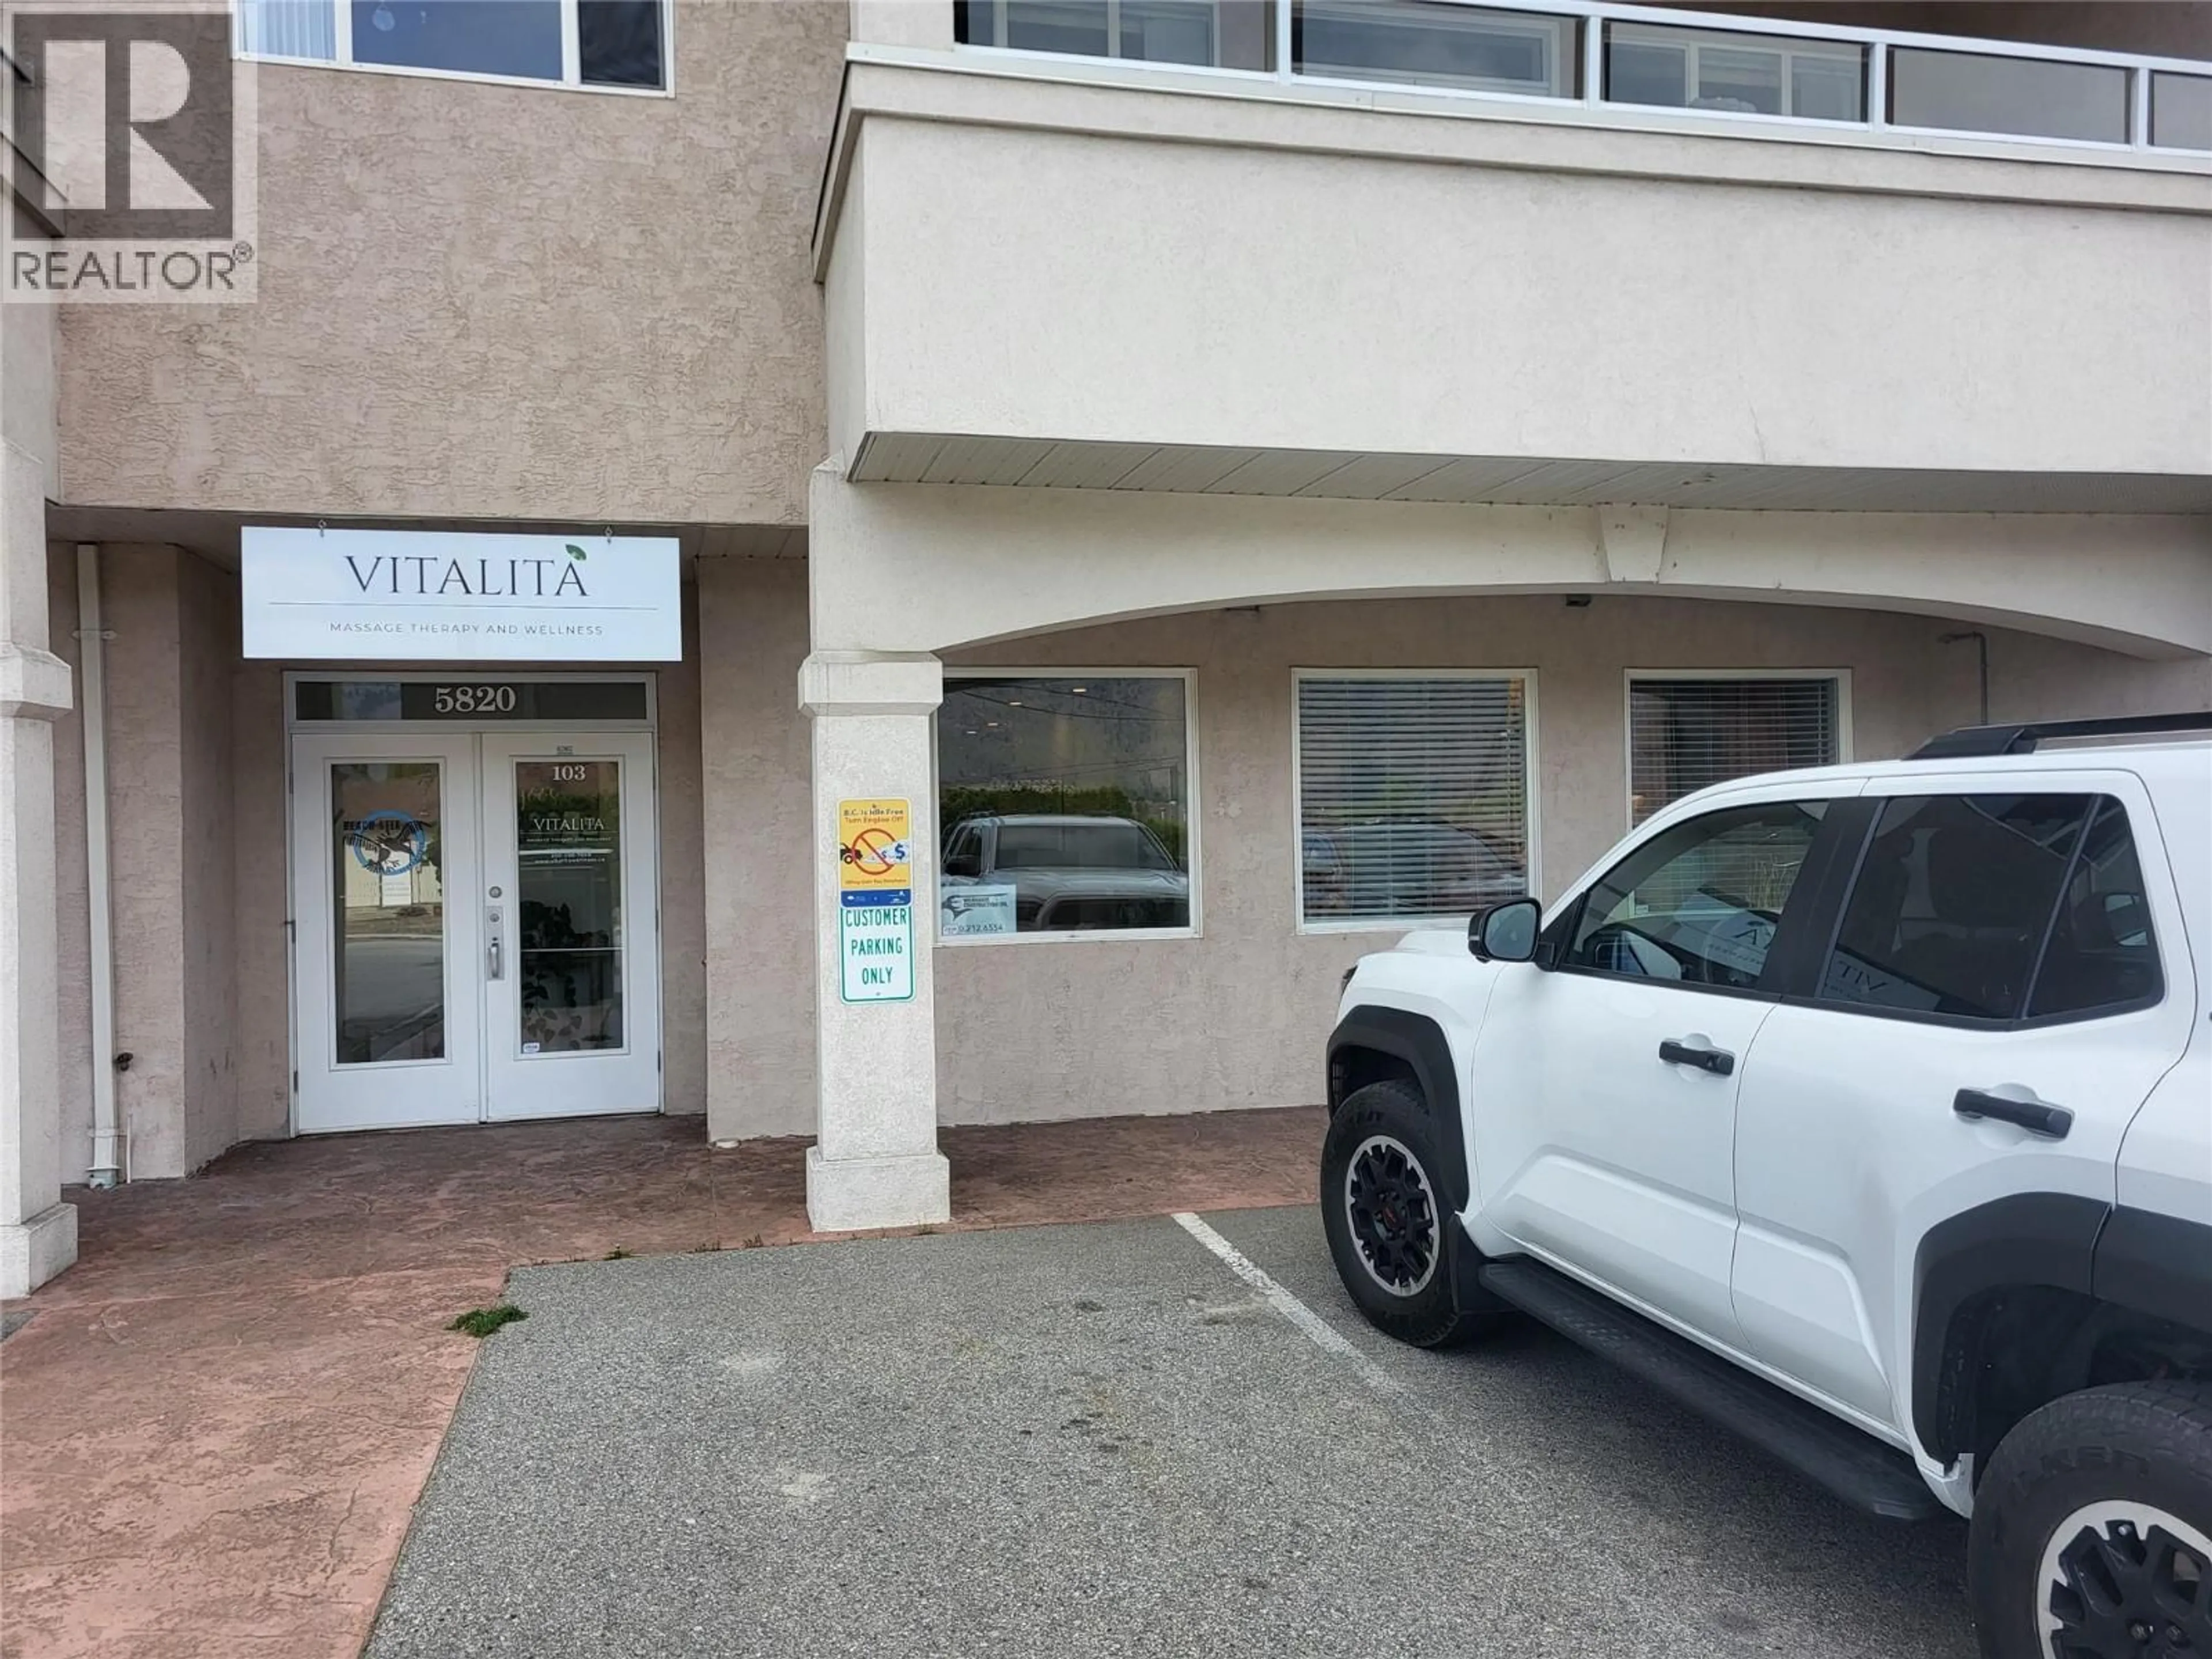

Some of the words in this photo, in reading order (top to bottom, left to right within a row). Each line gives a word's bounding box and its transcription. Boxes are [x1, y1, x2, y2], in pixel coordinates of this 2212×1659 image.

[330, 622, 404, 633] MASSAGE
[410, 623, 479, 634] THERAPY
[486, 624, 518, 635] AND
[524, 624, 603, 635] WELLNESS
[435, 686, 516, 713] 5820
[552, 764, 586, 782] 103
[846, 908, 907, 927] CUSTOMER
[851, 937, 903, 956] PARKING
[862, 966, 893, 985] ONLY
